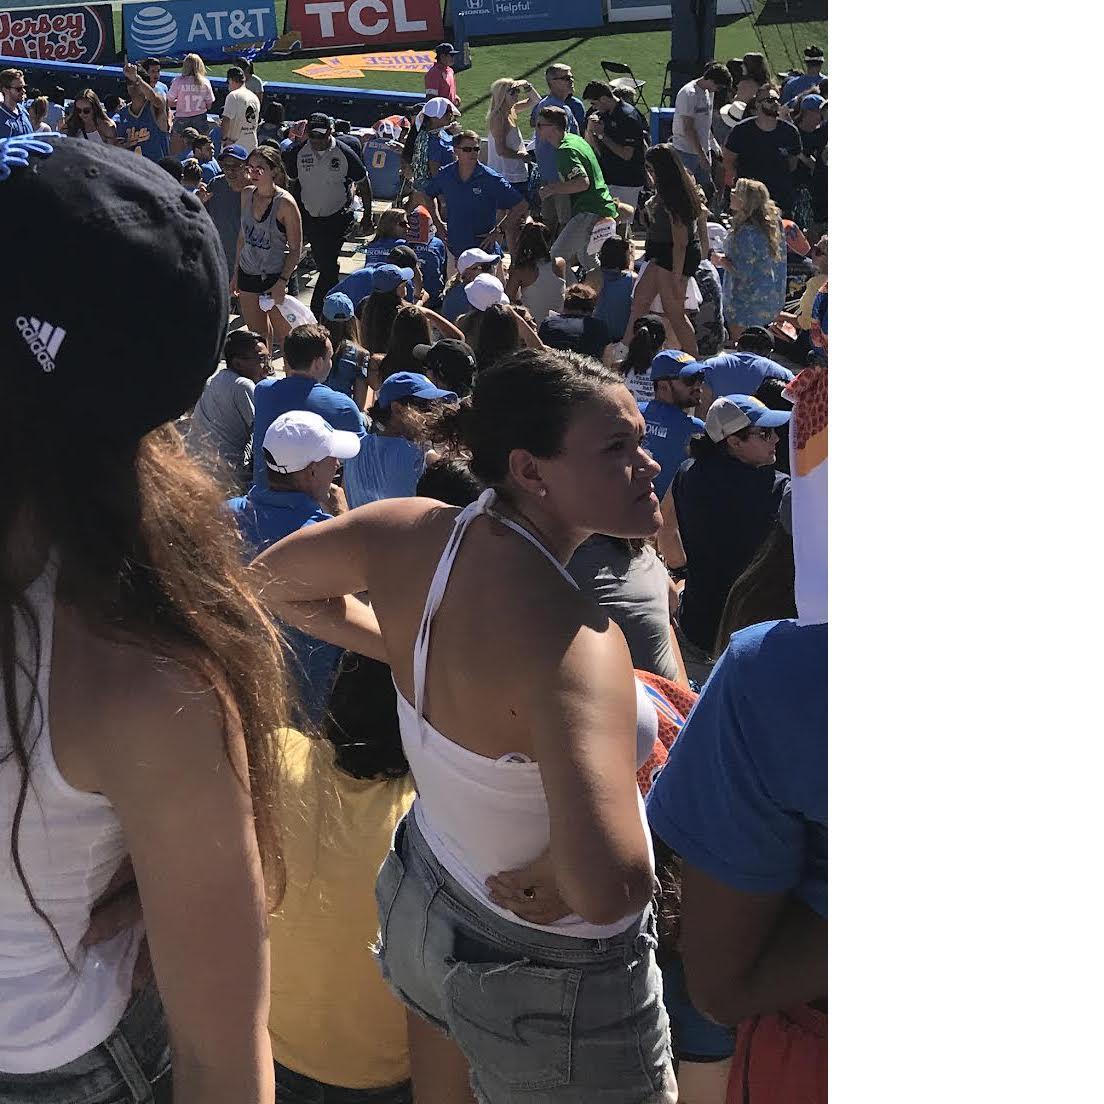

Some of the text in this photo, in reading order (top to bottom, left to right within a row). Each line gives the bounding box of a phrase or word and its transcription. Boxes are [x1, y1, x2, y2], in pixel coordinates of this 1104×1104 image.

[187, 7, 270, 43] AT&T
[496, 1, 530, 14] Helpful
[16, 316, 56, 372] adidas
